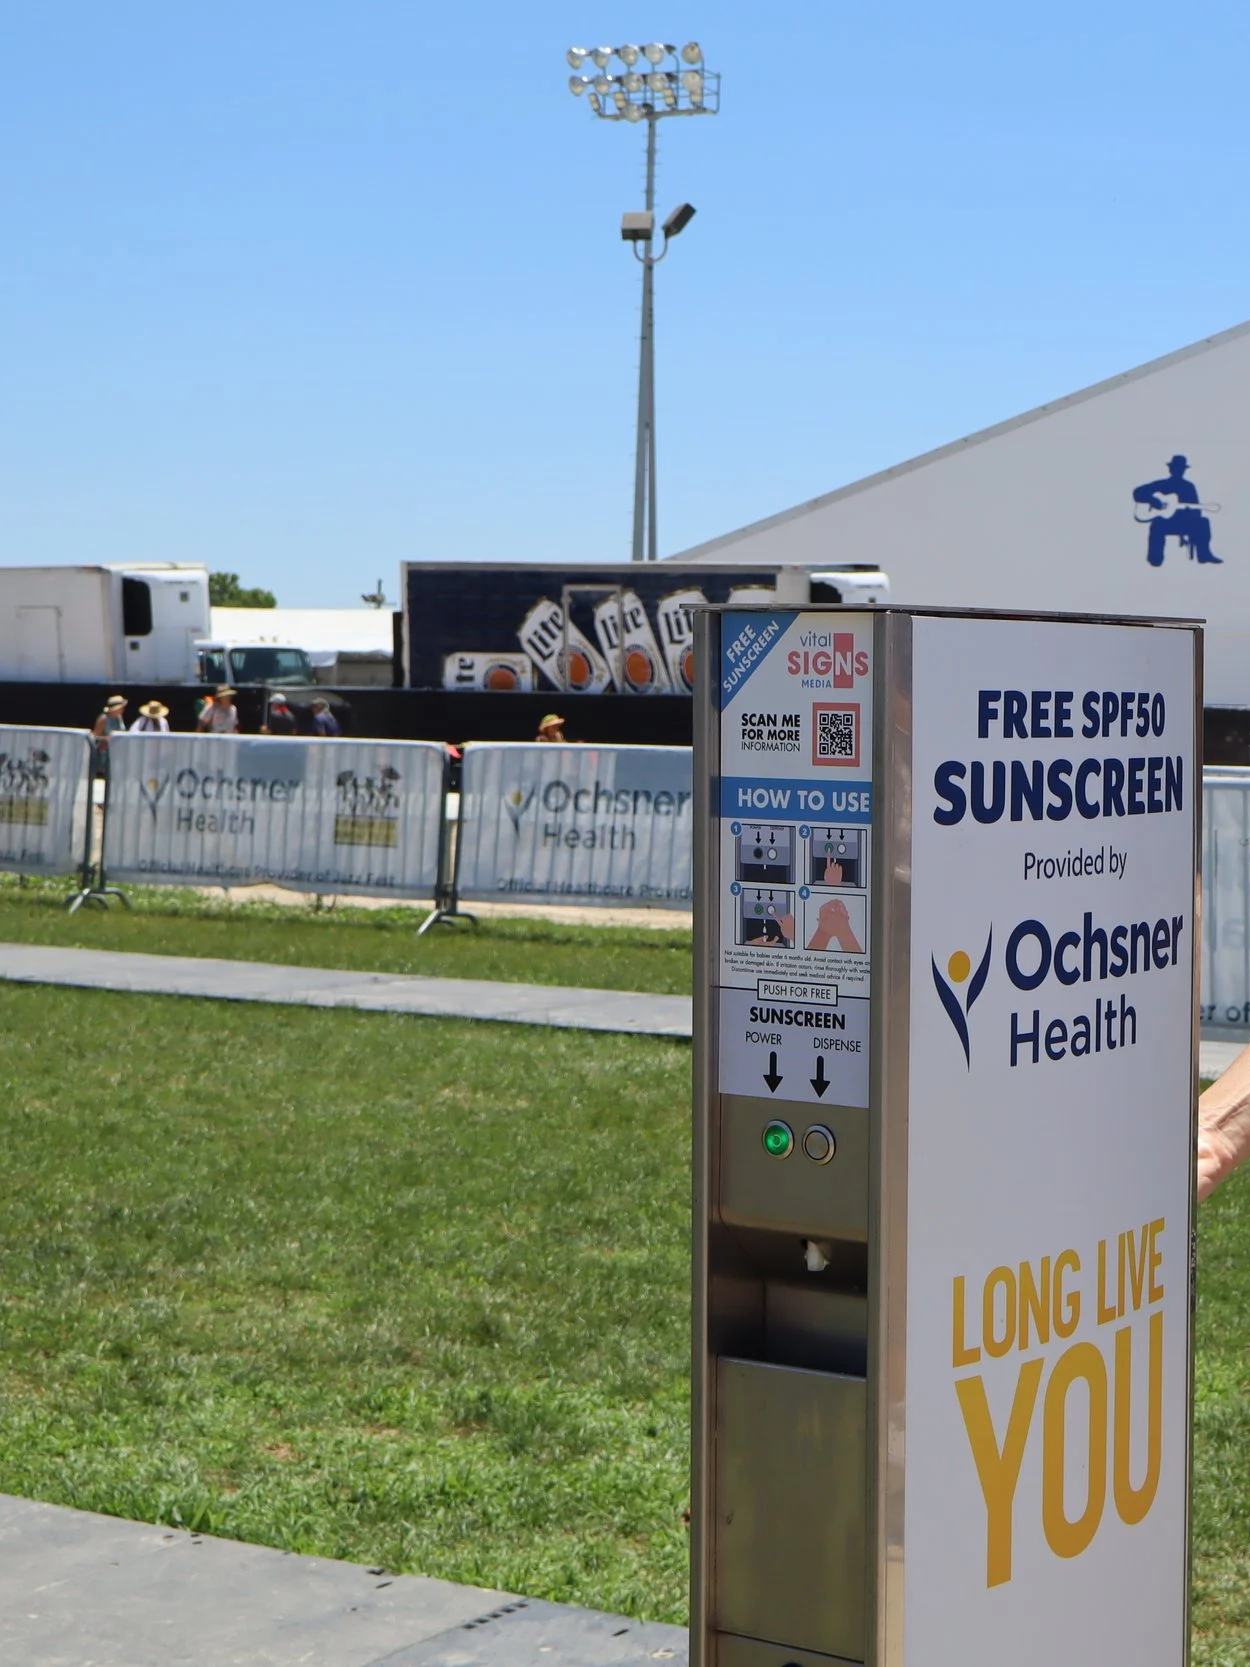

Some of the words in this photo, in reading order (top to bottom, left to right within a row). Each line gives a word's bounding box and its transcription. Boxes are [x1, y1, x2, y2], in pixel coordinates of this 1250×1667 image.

[663, 607, 693, 645] Lit
[726, 624, 757, 664] FREE
[800, 631, 832, 648] vital
[723, 620, 780, 693] SUNSCREEN
[787, 651, 869, 676] SIGNS
[801, 680, 832, 689] MEDIA
[741, 713, 777, 727] SCAN
[782, 714, 801, 728] ME
[978, 690, 1074, 739] FREE
[1081, 690, 1166, 739] SPF50
[741, 741, 800, 752] INFORMATION
[742, 729, 764, 740] FOR
[767, 729, 800, 741] MORE
[175, 768, 301, 803] Ochsner
[541, 780, 691, 817] Ochsner
[933, 756, 1183, 826] SUNSCREEN
[738, 788, 791, 809] HOW
[797, 791, 825, 811] TO
[832, 792, 870, 812] USE
[176, 808, 256, 835] Health
[543, 824, 636, 850] Health
[1024, 847, 1104, 880] Provided
[1109, 845, 1127, 880] by
[1005, 911, 1183, 991] Ochsner
[763, 985, 787, 996] PUSH
[790, 987, 807, 998] FOR
[811, 988, 831, 1000] FREE
[750, 1006, 845, 1030] SUNSCREEN
[1226, 1001, 1250, 1022] of
[745, 1031, 782, 1045] POWER
[1010, 993, 1137, 1067] Health
[813, 1037, 861, 1053] DISPENSE
[952, 1248, 1081, 1368] LONG
[1097, 1217, 1165, 1326] LIVE
[954, 1310, 1164, 1589] YOU
